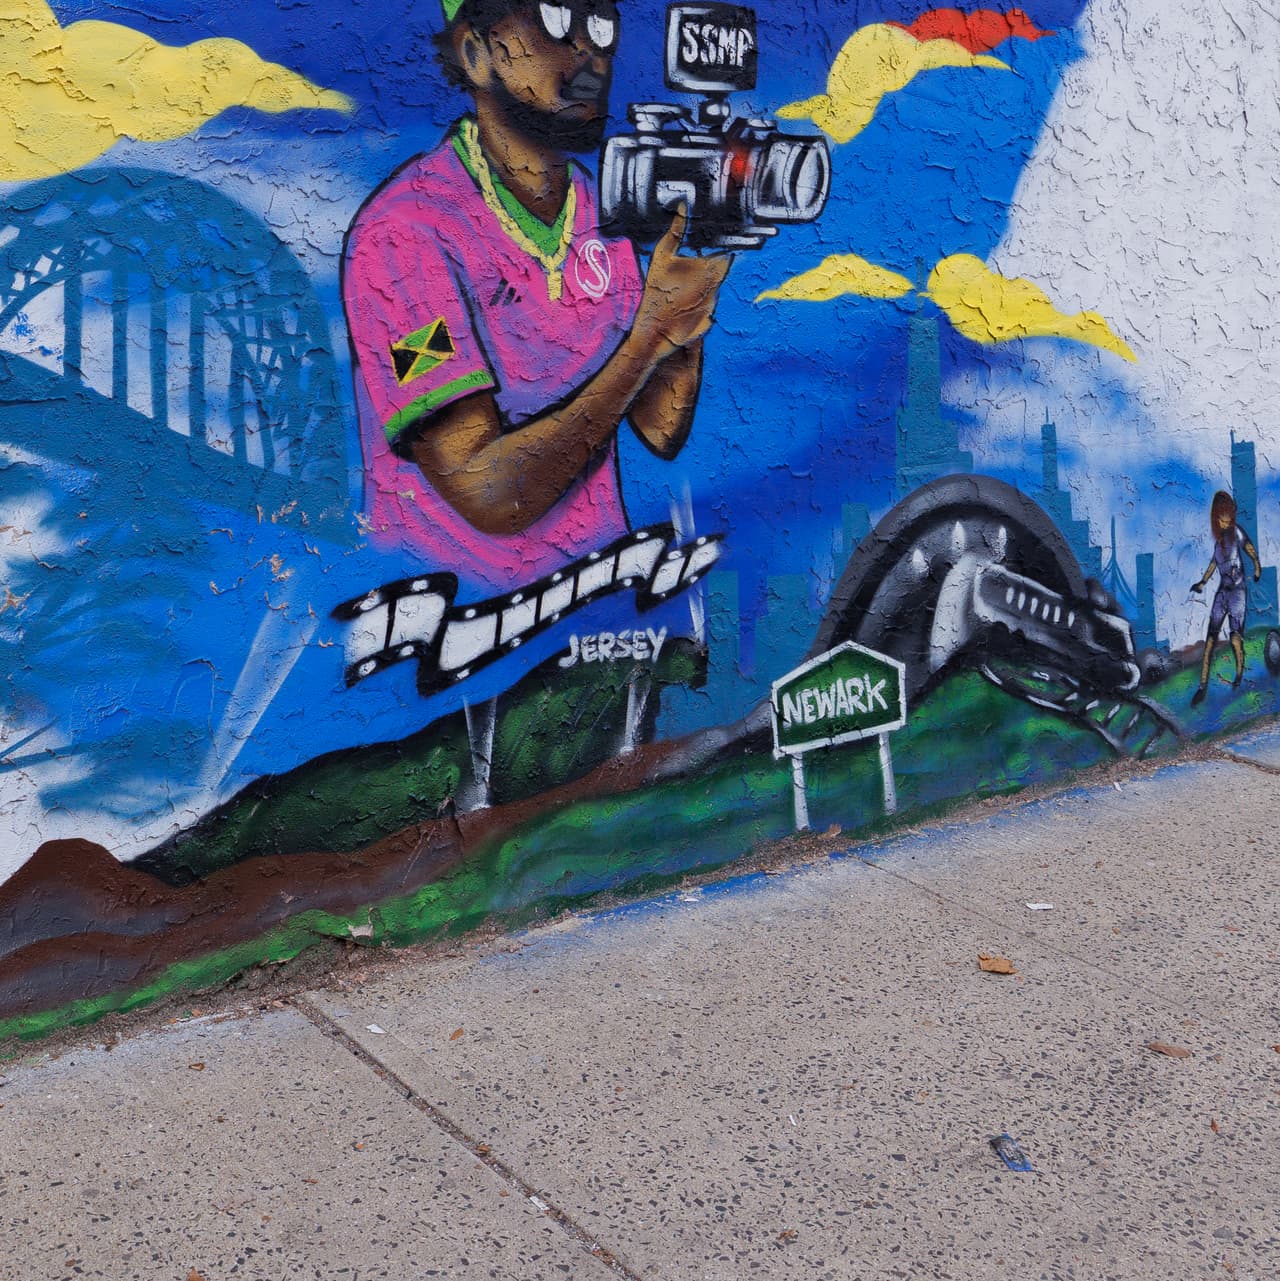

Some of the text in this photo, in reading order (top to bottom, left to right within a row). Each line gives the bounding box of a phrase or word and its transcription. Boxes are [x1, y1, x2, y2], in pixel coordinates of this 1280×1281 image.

[682, 22, 754, 68] SSMP
[558, 626, 668, 669] JERSEY
[782, 673, 889, 726] NEWARK
